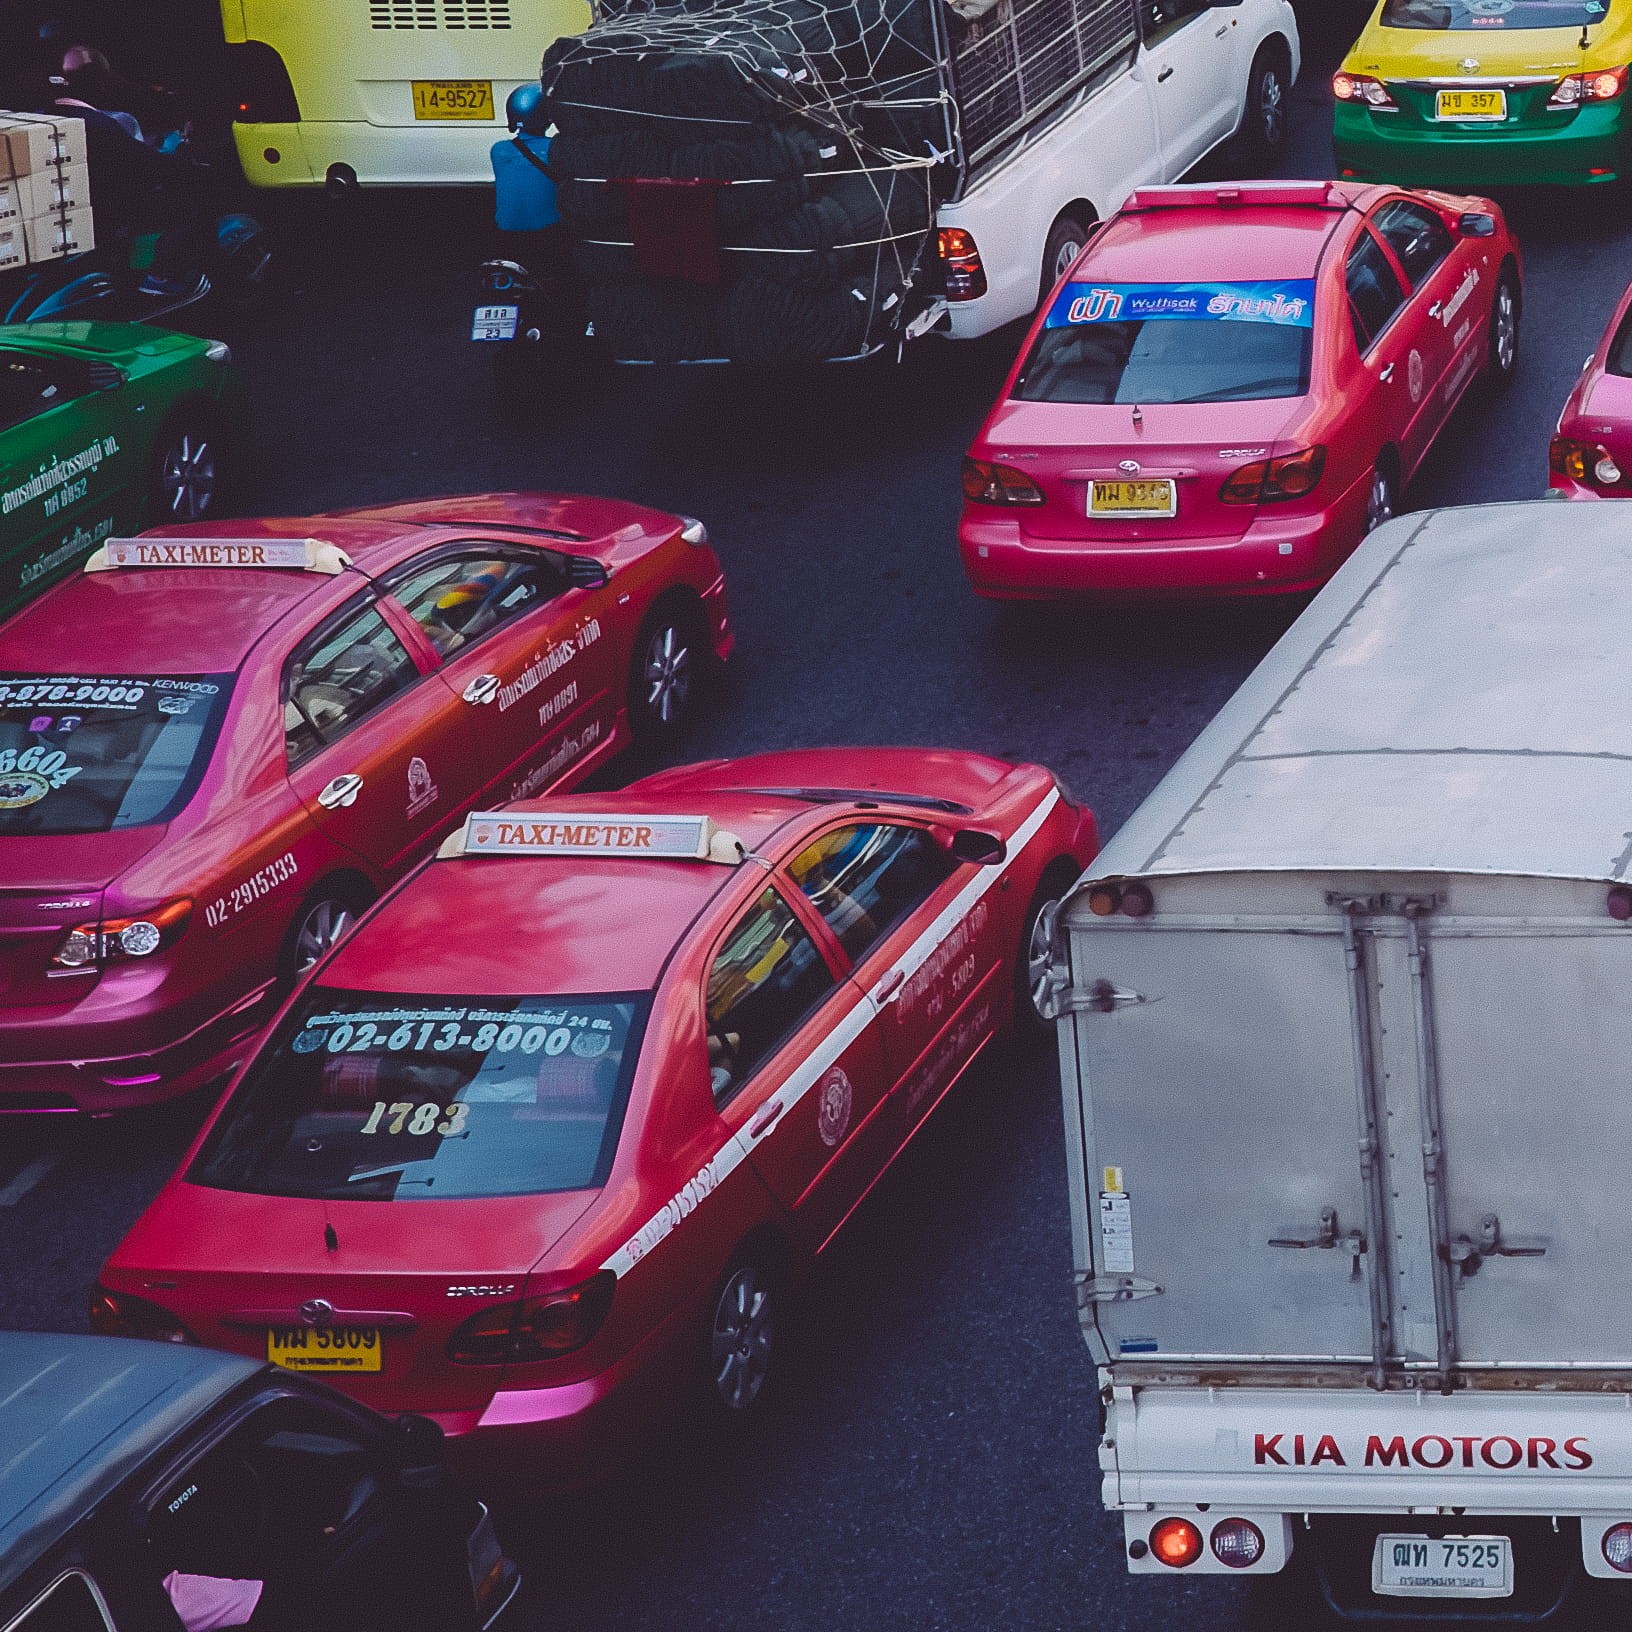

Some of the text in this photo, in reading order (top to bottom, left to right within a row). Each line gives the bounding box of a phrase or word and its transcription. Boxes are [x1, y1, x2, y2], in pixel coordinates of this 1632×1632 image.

[419, 89, 488, 112] 14-9527
[1470, 95, 1496, 111] 357
[136, 544, 266, 566] TAXI-METER
[152, 679, 220, 696] KENWOOD
[497, 822, 652, 847] TAXI-METER
[204, 851, 299, 929] 02-2915333
[326, 1021, 572, 1057] 02-613-8000
[359, 1101, 471, 1137] 1783
[1254, 1434, 1594, 1470] KIA MOTORS
[1442, 1541, 1500, 1569] 7525
